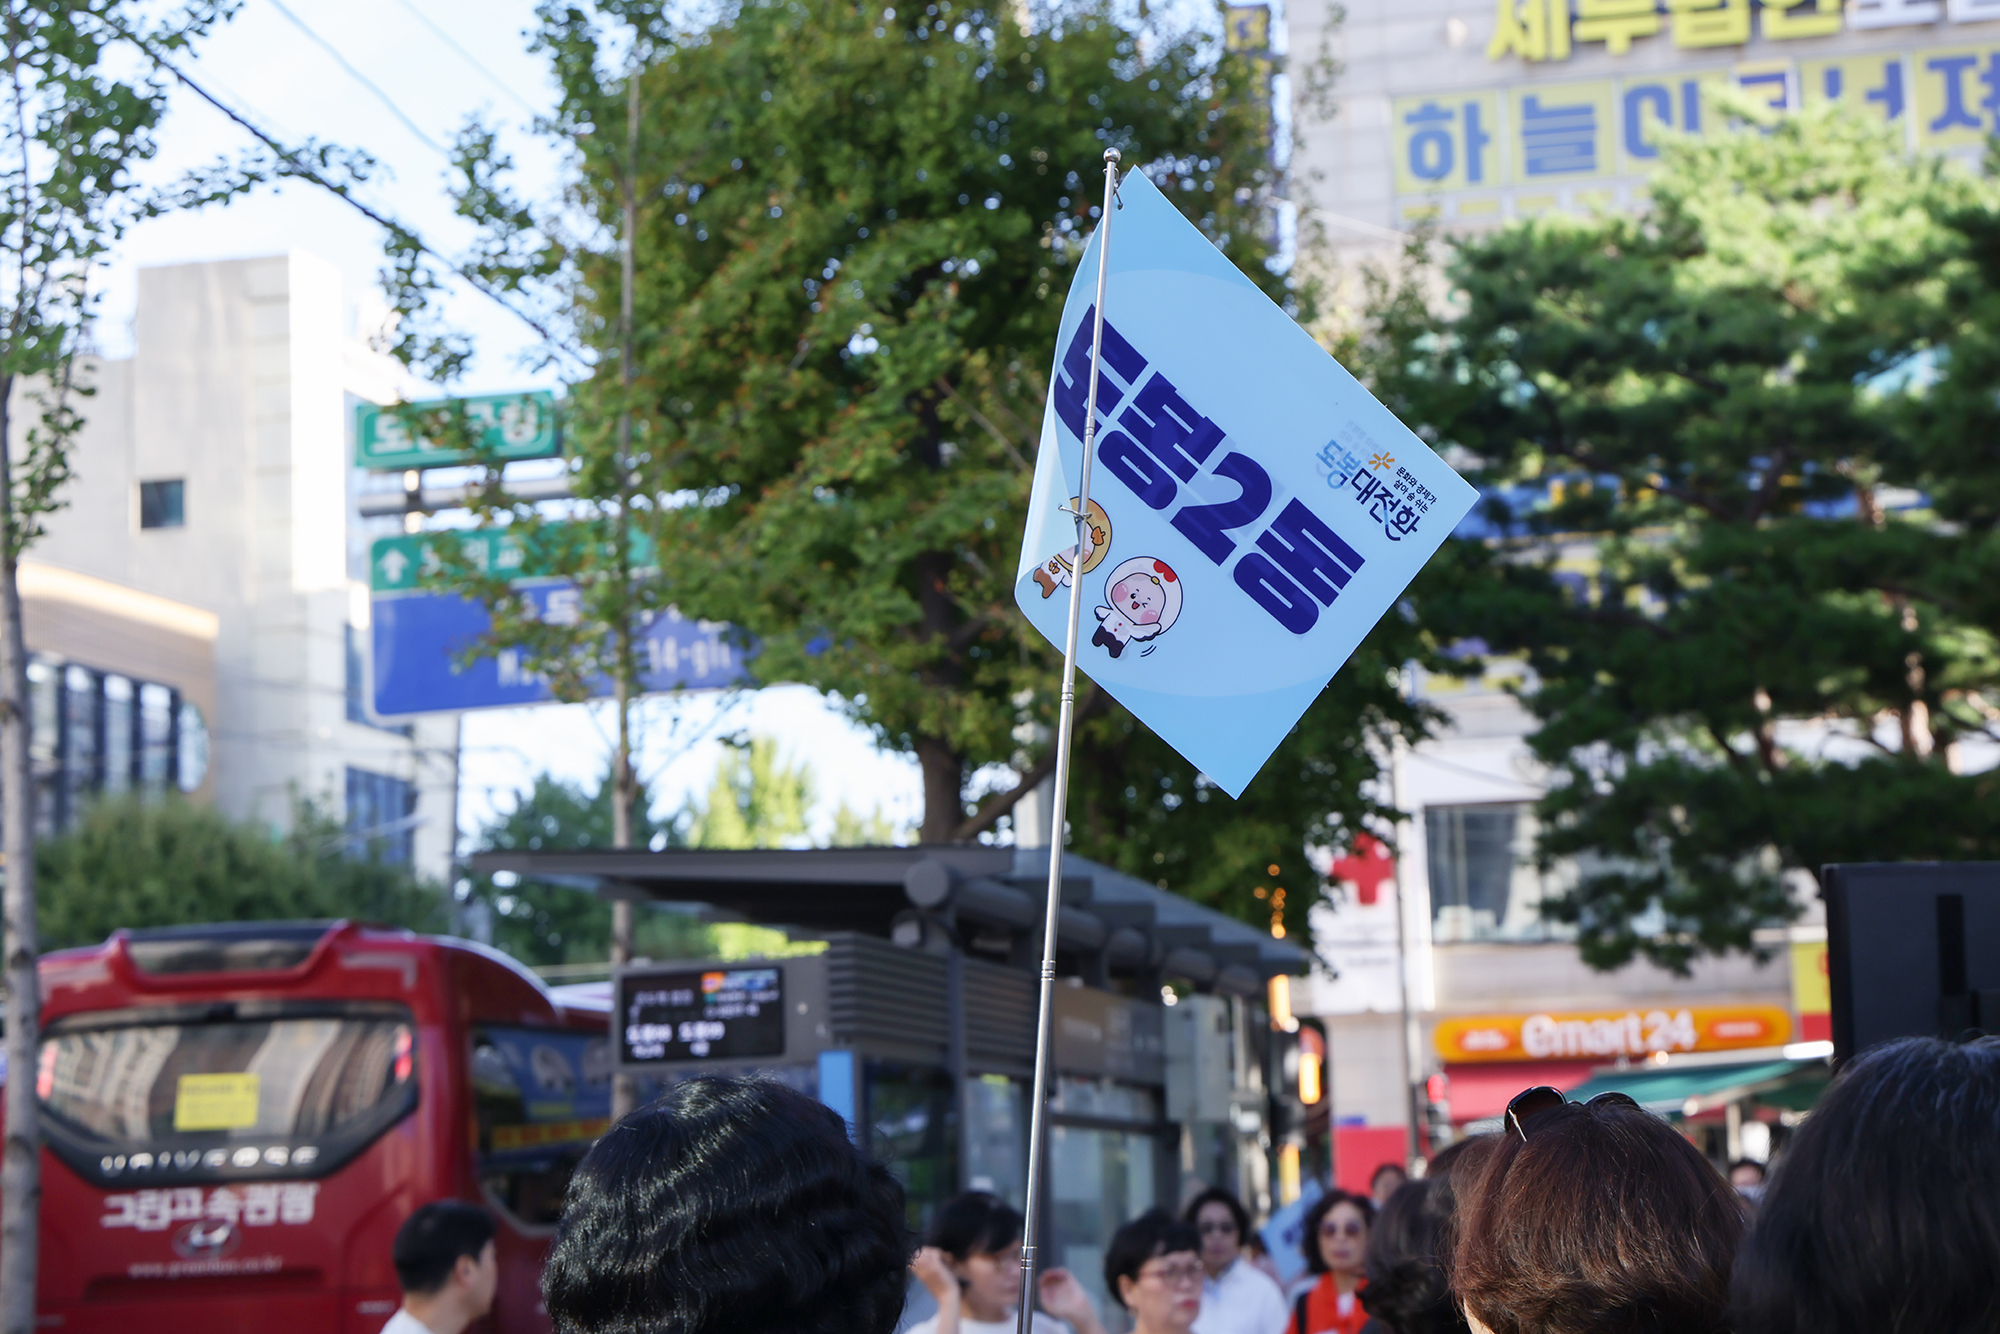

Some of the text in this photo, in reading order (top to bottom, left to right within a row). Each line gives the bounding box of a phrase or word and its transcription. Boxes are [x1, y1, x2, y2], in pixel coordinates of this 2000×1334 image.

[1054, 303, 1366, 635] 도봉2동
[1395, 466, 1438, 505] 문화와 경제가
